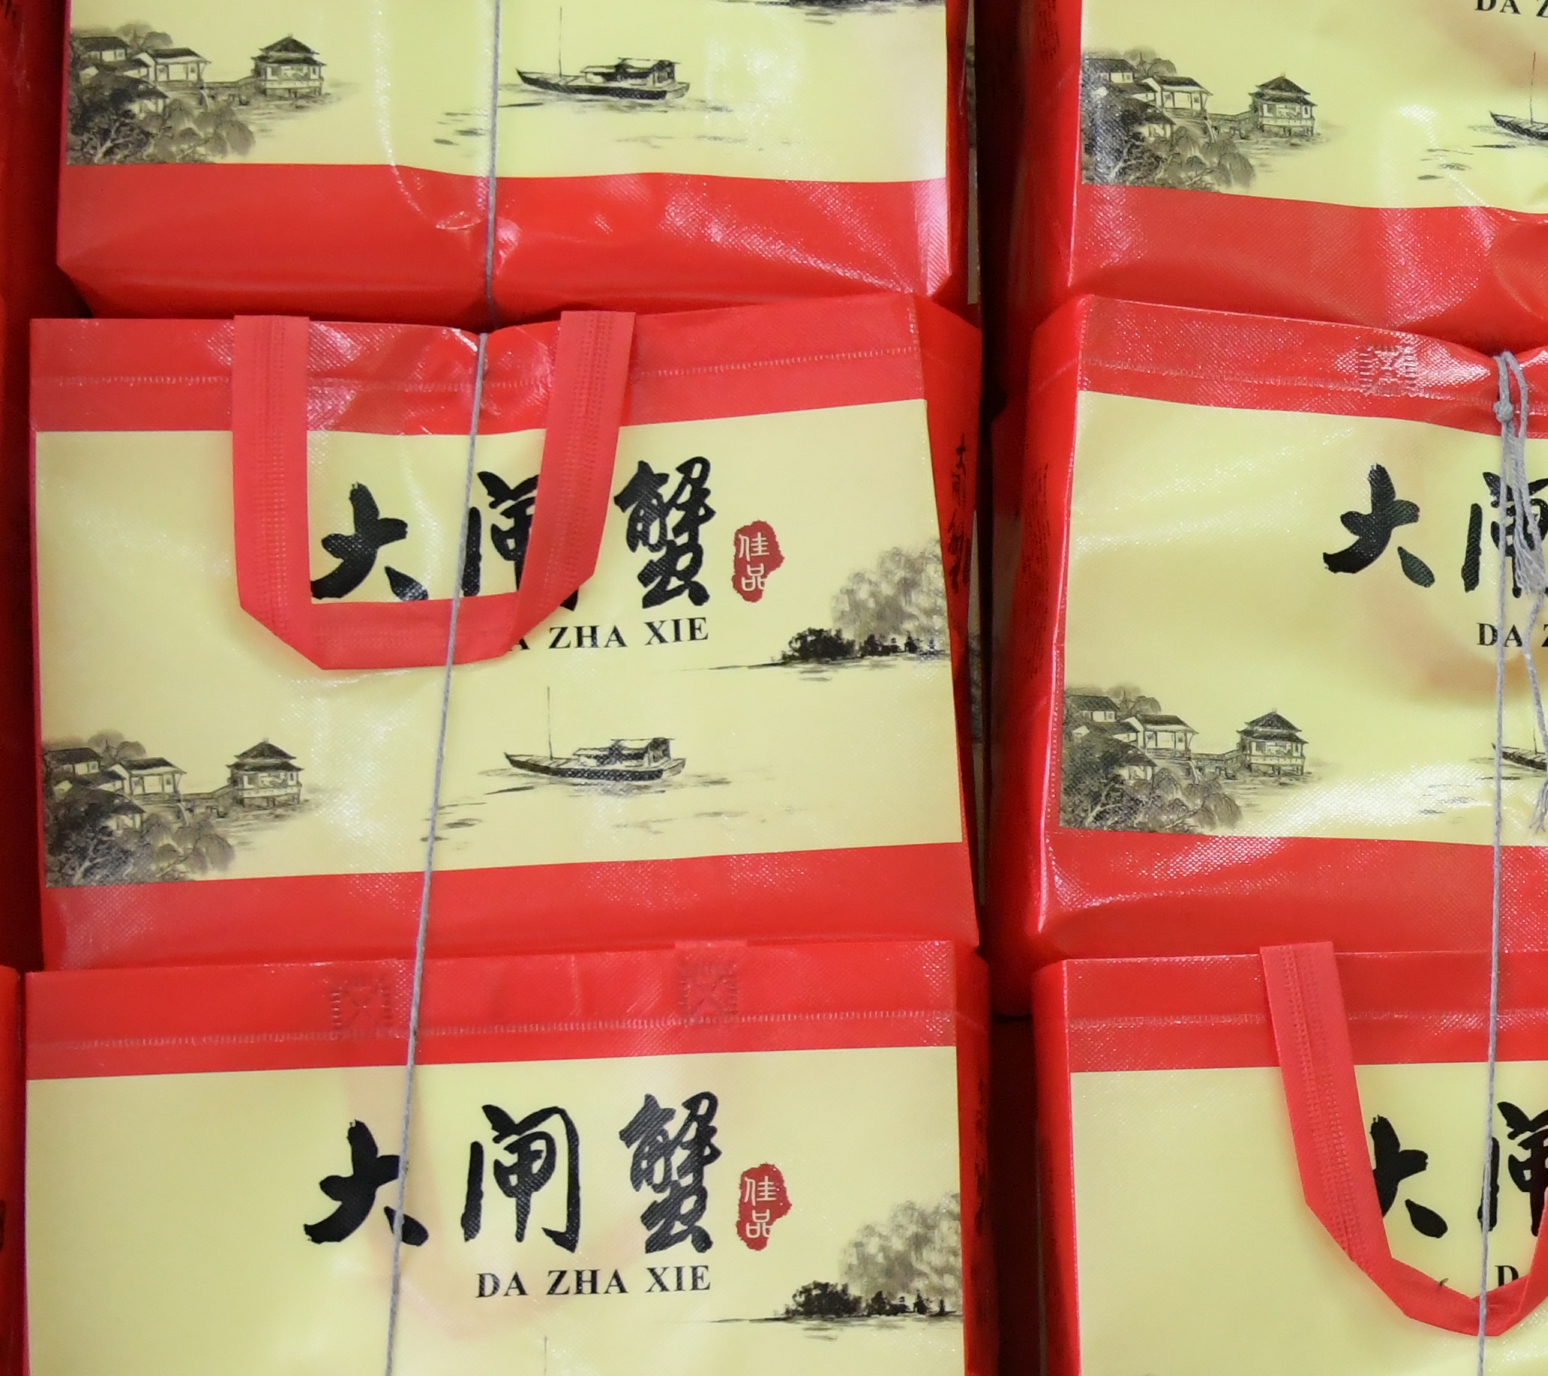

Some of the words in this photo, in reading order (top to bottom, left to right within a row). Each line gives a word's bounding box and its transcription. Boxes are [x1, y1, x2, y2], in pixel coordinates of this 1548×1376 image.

[739, 532, 770, 592] 佳品
[550, 620, 627, 651] ZHA
[643, 616, 710, 644] XIE
[1477, 622, 1522, 649] DA
[305, 1090, 721, 1254] 大闸蟹
[742, 1174, 777, 1237] 佳品
[476, 1271, 527, 1298] DA
[546, 1268, 627, 1296] ZHA
[645, 1264, 711, 1292] XIE
